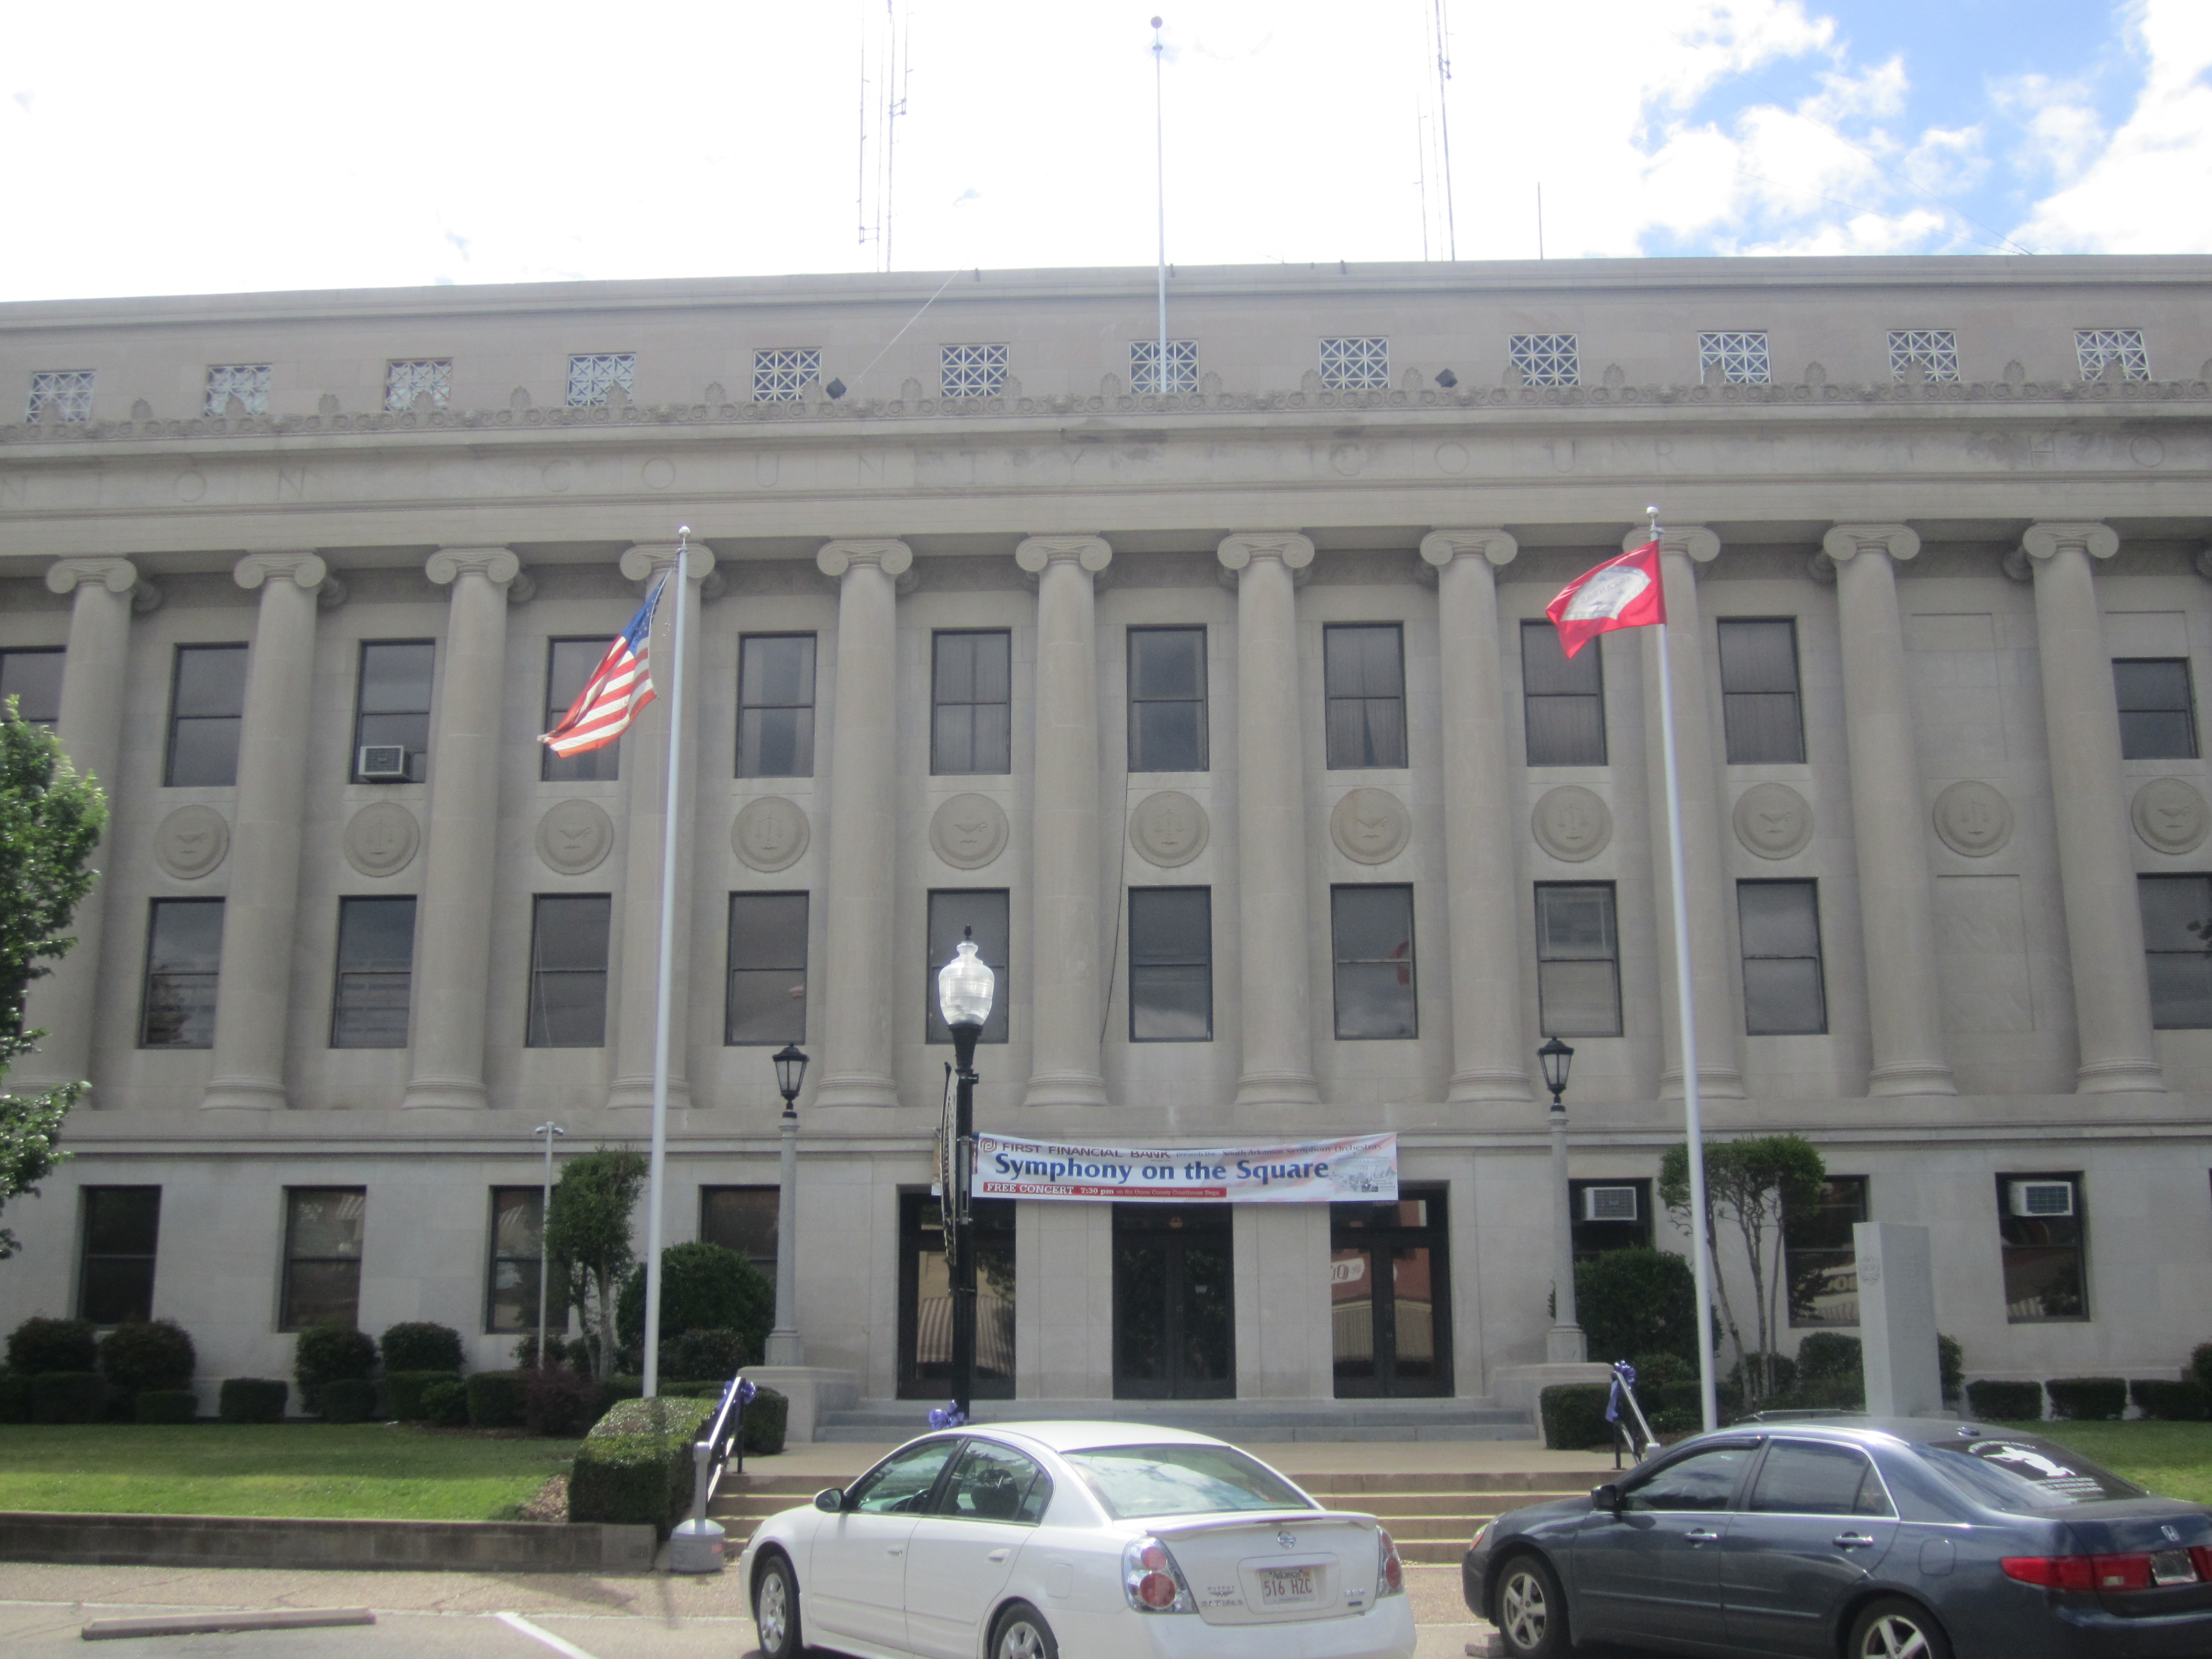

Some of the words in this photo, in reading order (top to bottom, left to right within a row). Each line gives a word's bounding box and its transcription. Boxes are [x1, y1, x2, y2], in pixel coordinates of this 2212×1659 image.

[1002, 1142, 1041, 1153] FIRST
[1049, 1146, 1123, 1158] FINANCIAL
[1286, 1145, 1332, 1154] Symphony
[995, 1153, 1133, 1184] Symphony
[1142, 1165, 1175, 1180] on
[1184, 1161, 1226, 1180] the
[1237, 1160, 1329, 1185] Square
[987, 1183, 1016, 1193] FREE
[1019, 1185, 1074, 1195] CONCERT
[1264, 1580, 1285, 1597] 516
[1291, 1578, 1312, 1594] HZC
